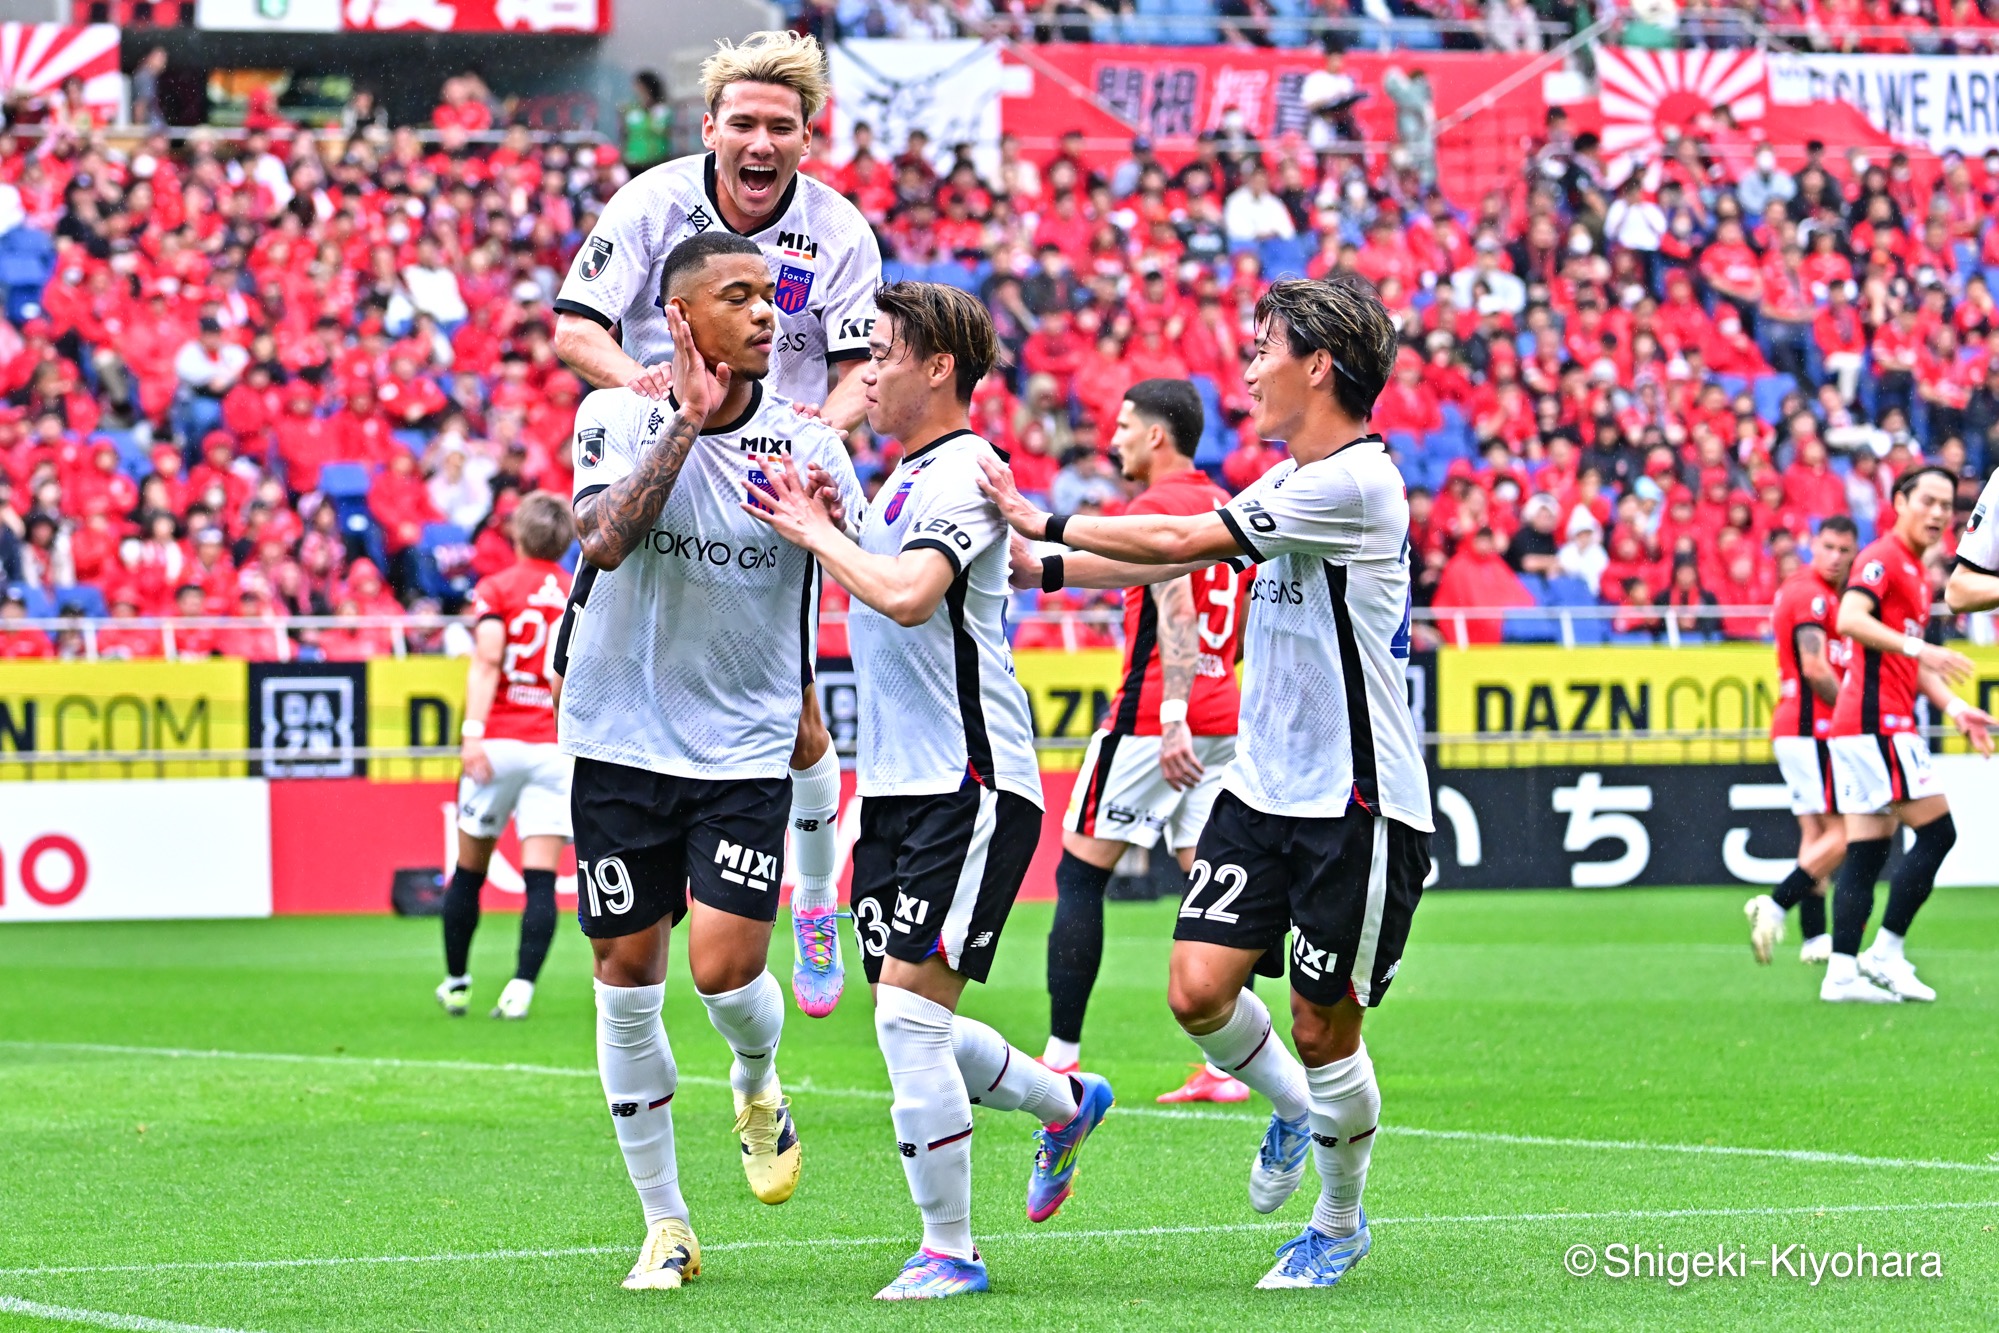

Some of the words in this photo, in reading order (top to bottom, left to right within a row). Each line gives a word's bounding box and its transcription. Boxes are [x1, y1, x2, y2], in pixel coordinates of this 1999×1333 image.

[1944, 71, 1999, 134] AR
[782, 271, 810, 284] TOKYO
[740, 436, 792, 456] MIXI
[751, 477, 769, 485] TOK
[644, 528, 731, 566] TOKYO
[737, 545, 779, 570] GAS
[1267, 579, 1304, 605] GAS
[1474, 681, 1652, 739] DAZN
[714, 839, 777, 882] MIXI
[578, 855, 635, 918] 19
[1178, 858, 1249, 925] 22
